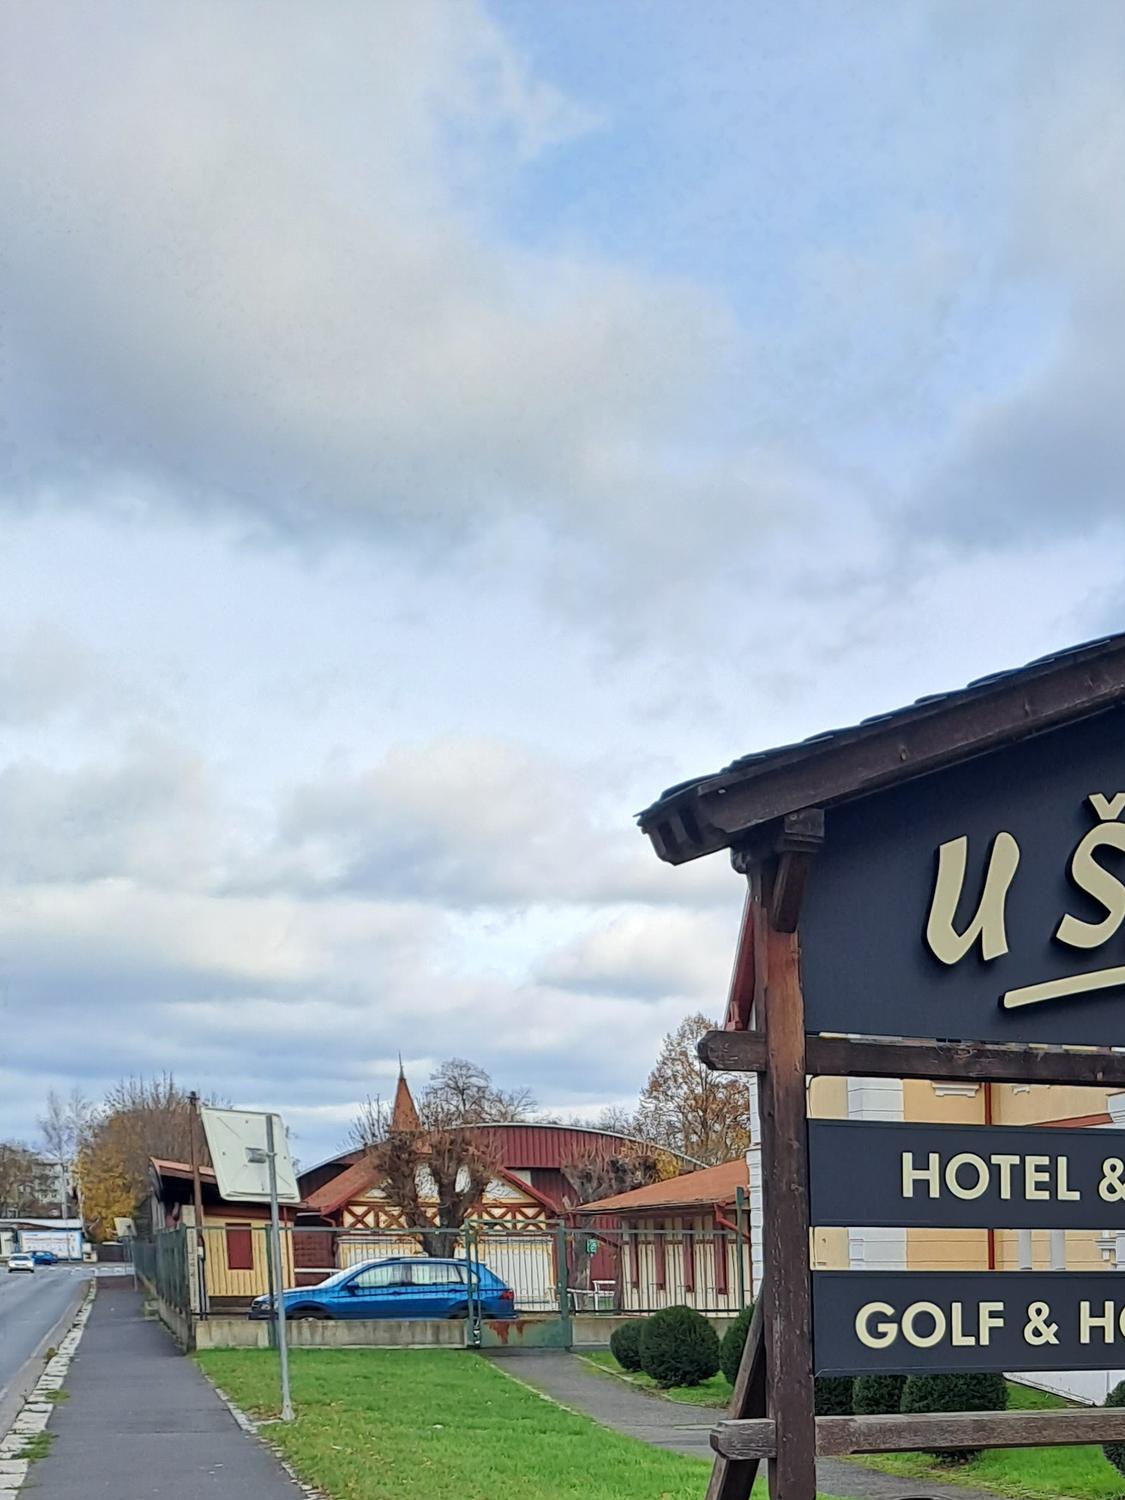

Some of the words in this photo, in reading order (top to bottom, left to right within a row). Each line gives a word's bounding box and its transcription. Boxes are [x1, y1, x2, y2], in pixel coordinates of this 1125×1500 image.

[901, 1152, 1081, 1201] HOTEL
[855, 1301, 1004, 1349] GOLF
[1023, 1301, 1060, 1346] &
